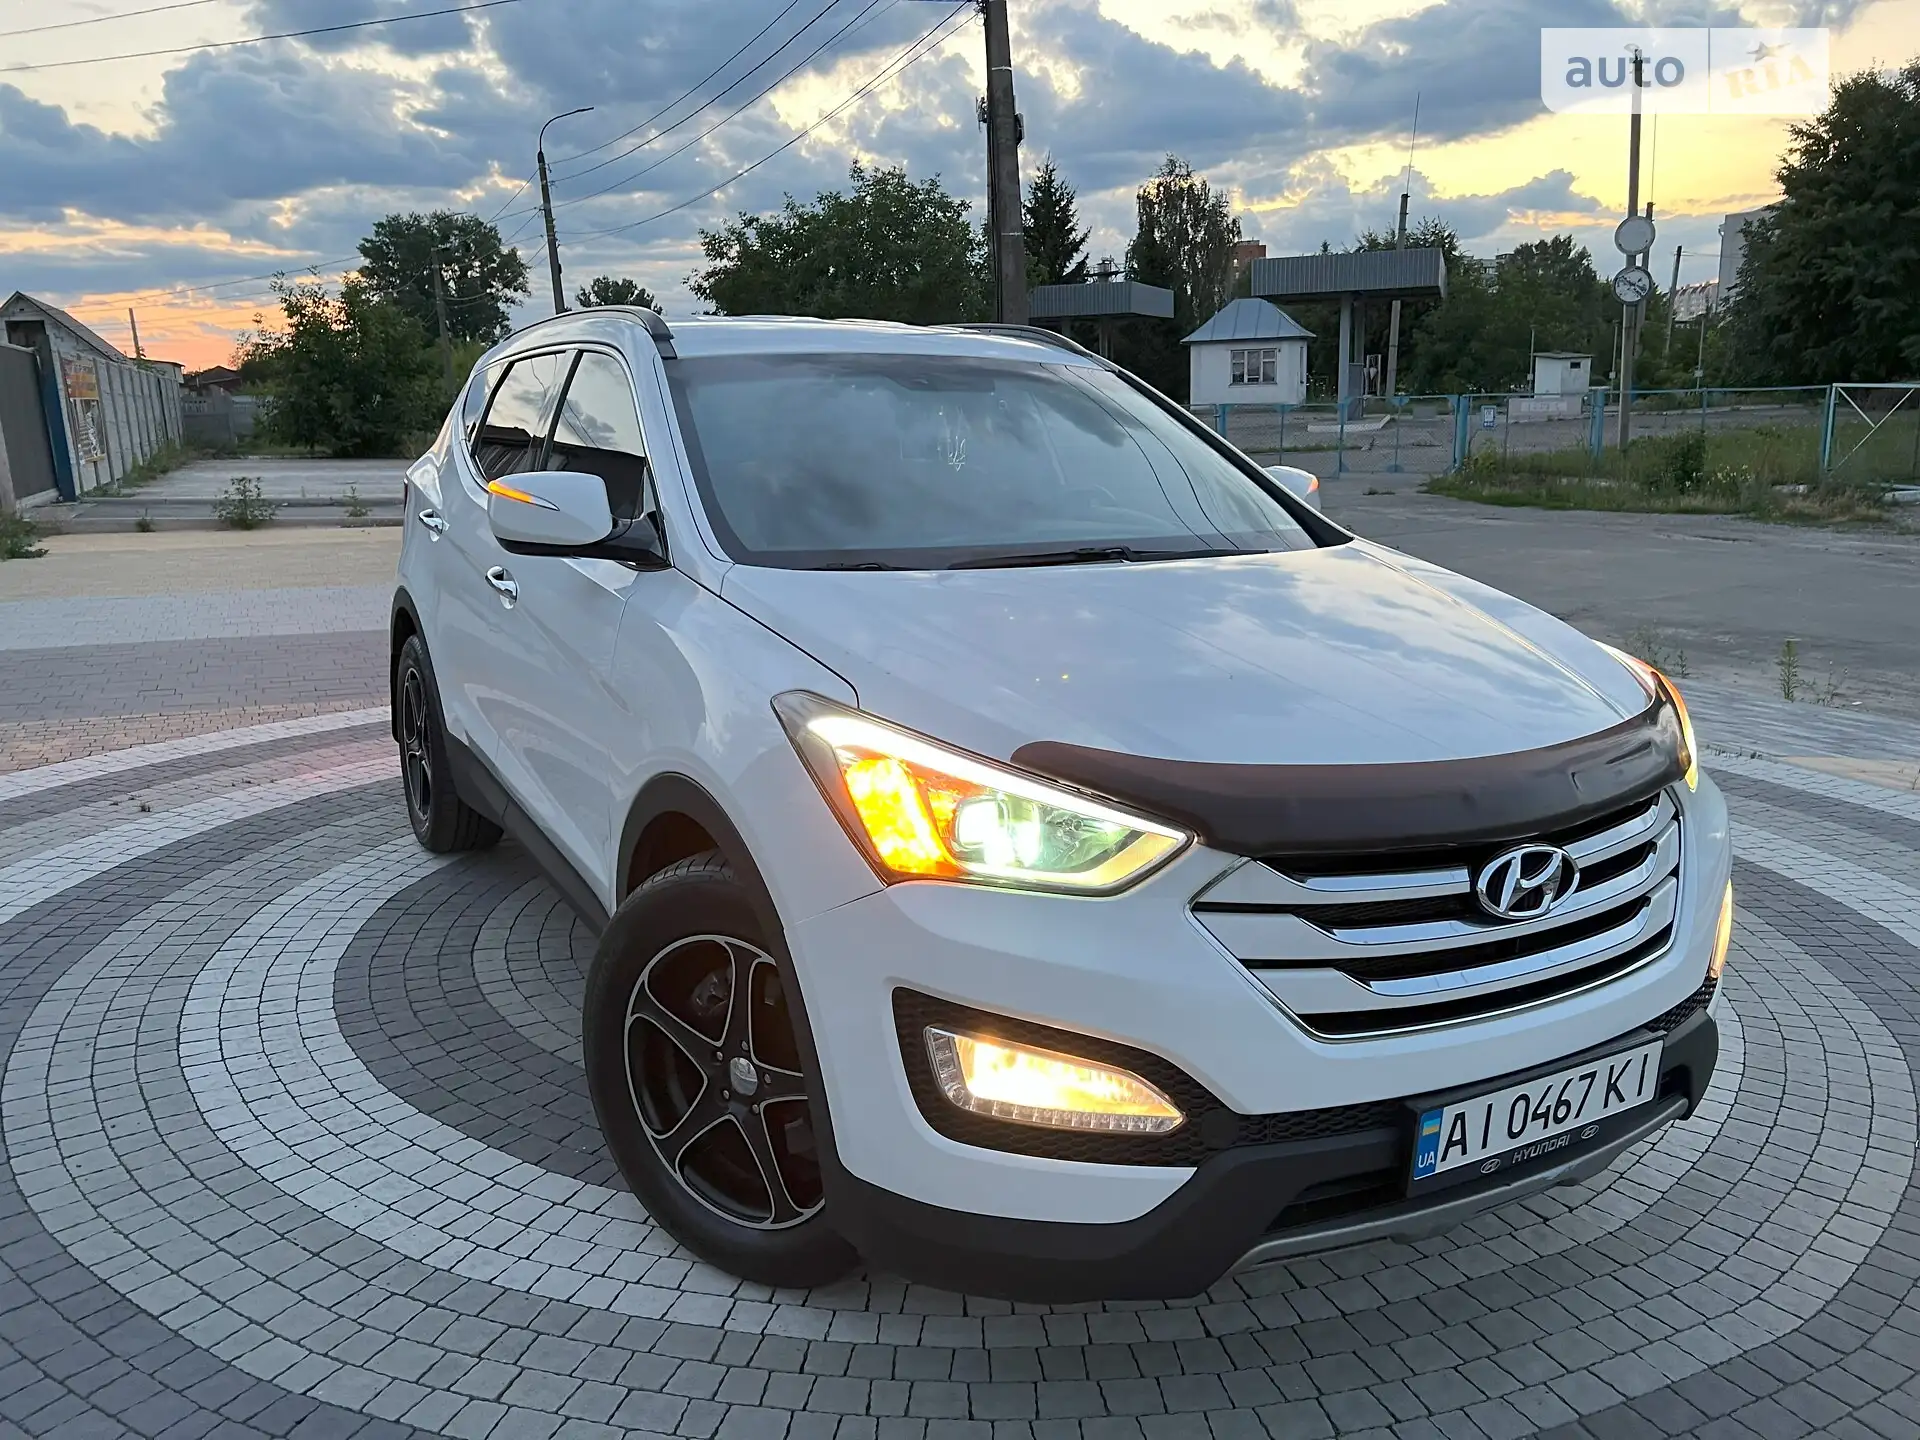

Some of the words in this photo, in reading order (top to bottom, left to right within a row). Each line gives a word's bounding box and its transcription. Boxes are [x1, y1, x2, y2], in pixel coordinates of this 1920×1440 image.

[1440, 1102, 1494, 1163] AI
[1507, 1069, 1598, 1140] 0467
[1602, 1053, 1649, 1109] KI
[1418, 1153, 1435, 1168] UA
[1512, 1134, 1571, 1164] HYUNDAI
